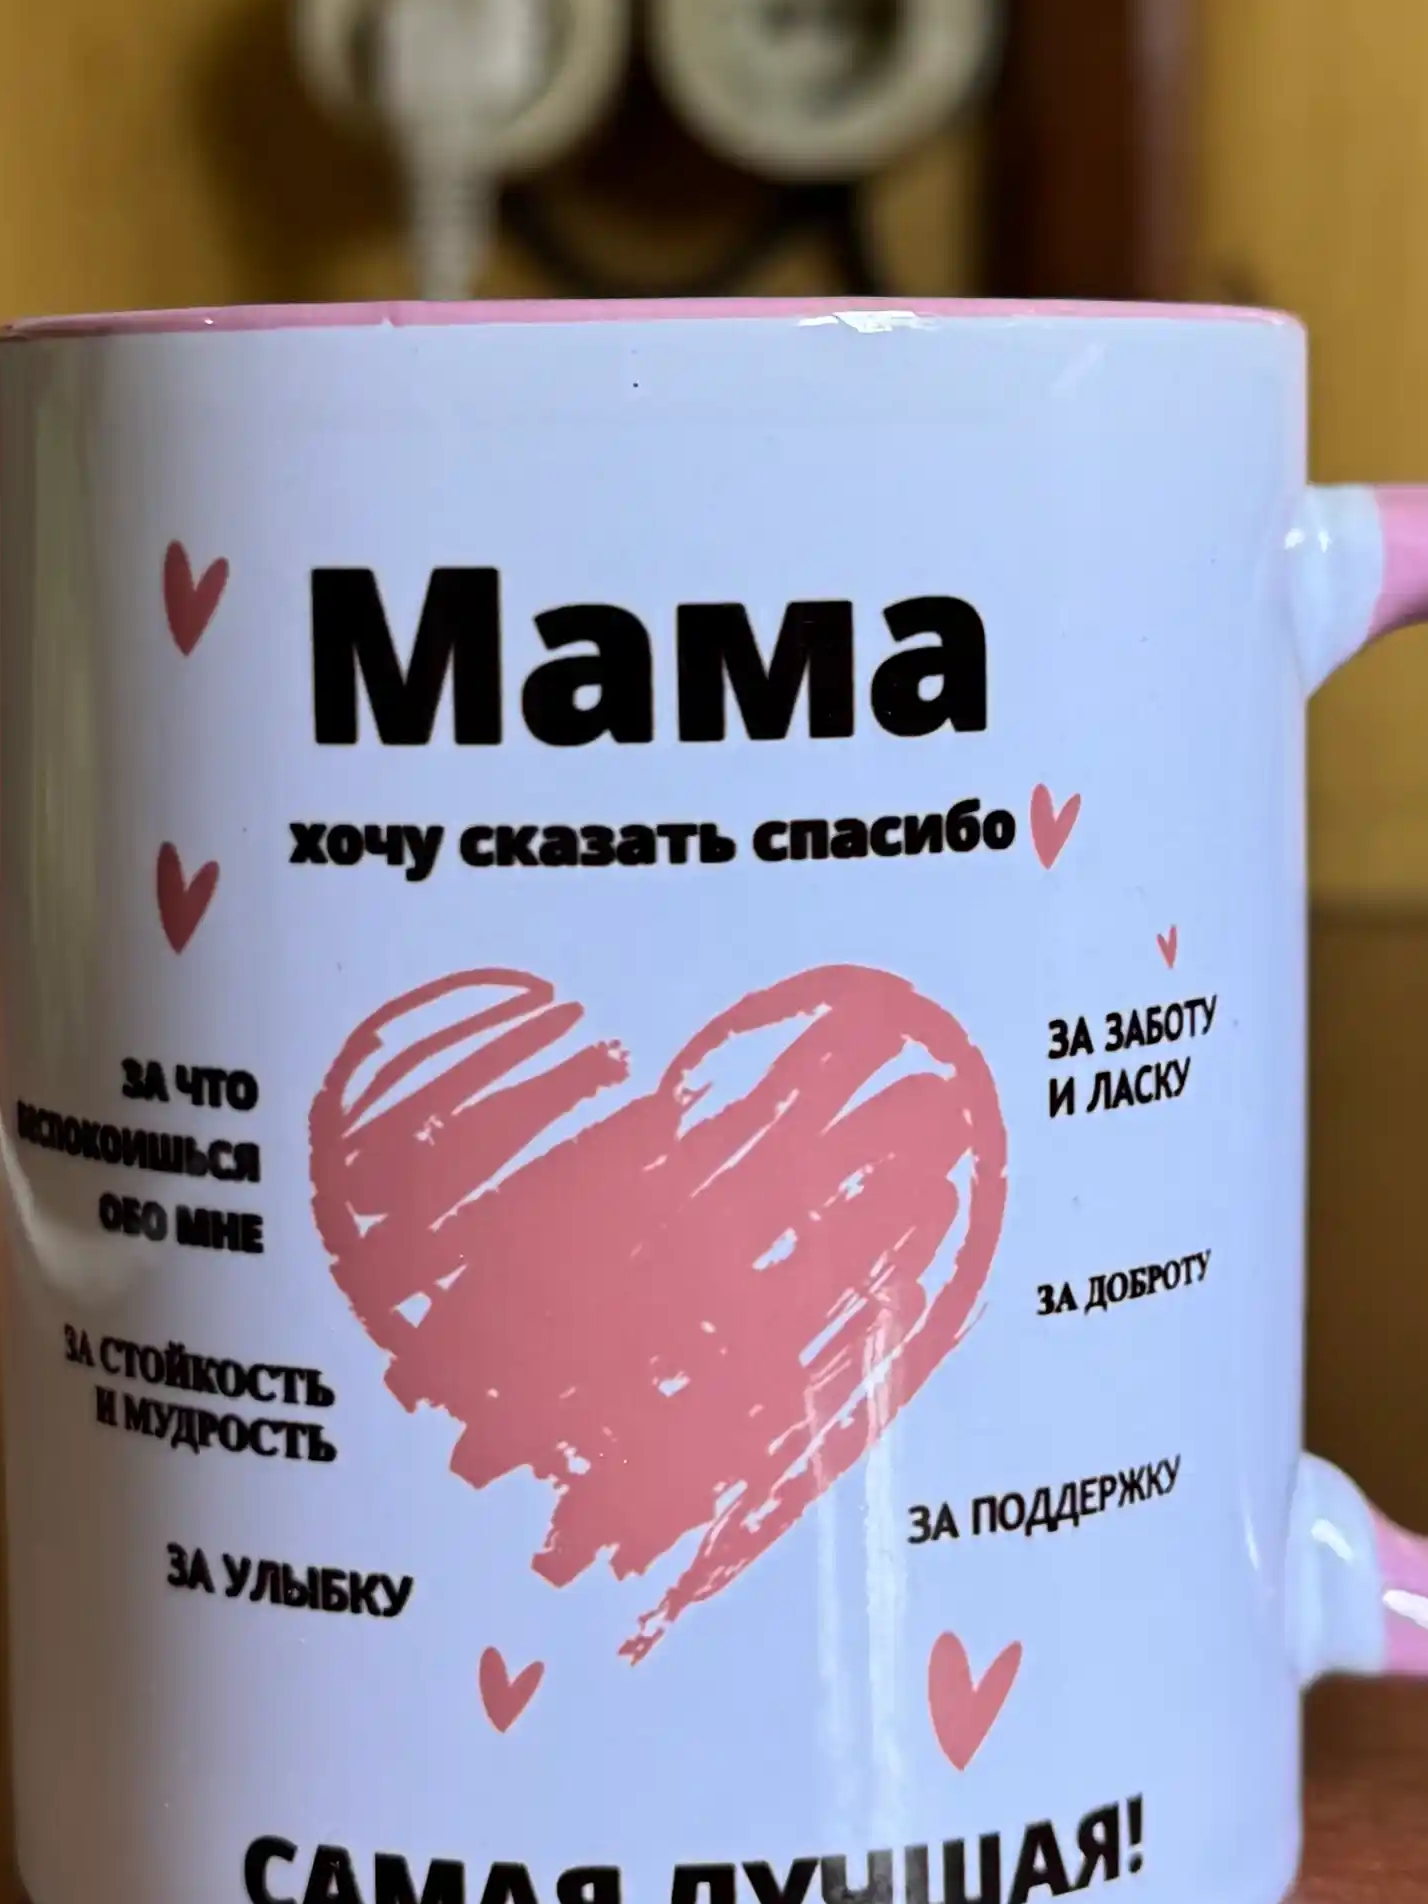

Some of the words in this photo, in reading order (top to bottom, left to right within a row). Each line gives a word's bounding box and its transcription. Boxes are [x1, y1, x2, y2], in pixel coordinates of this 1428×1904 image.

[311, 567, 986, 746] Мама
[289, 822, 445, 881] хочу
[459, 822, 737, 868] сказать
[752, 798, 1016, 862] спасибо
[1048, 1017, 1095, 1059] ЗА
[1104, 994, 1217, 1051] ЗАБОТУ
[121, 1057, 169, 1102] ЗА
[175, 1064, 259, 1111] ЧТО
[1049, 1077, 1075, 1118] И
[1086, 1056, 1191, 1112] ЛАСКУ
[98, 1192, 168, 1242] ОБО
[176, 1205, 264, 1254] МНЕ
[1037, 1282, 1079, 1316] ЗА
[1084, 1249, 1212, 1315] ДОБРОТУ
[63, 1324, 95, 1367] ЗА
[99, 1340, 336, 1408] СТОЙКОСТЬ
[95, 1385, 118, 1427] И
[124, 1392, 338, 1463] МУДРОСТЬ
[908, 1502, 960, 1545] ЗА
[972, 1455, 1181, 1538] ПОДДЕРЖКУ
[166, 1543, 215, 1594] ЗА
[222, 1553, 414, 1618] УЛЫБКУ
